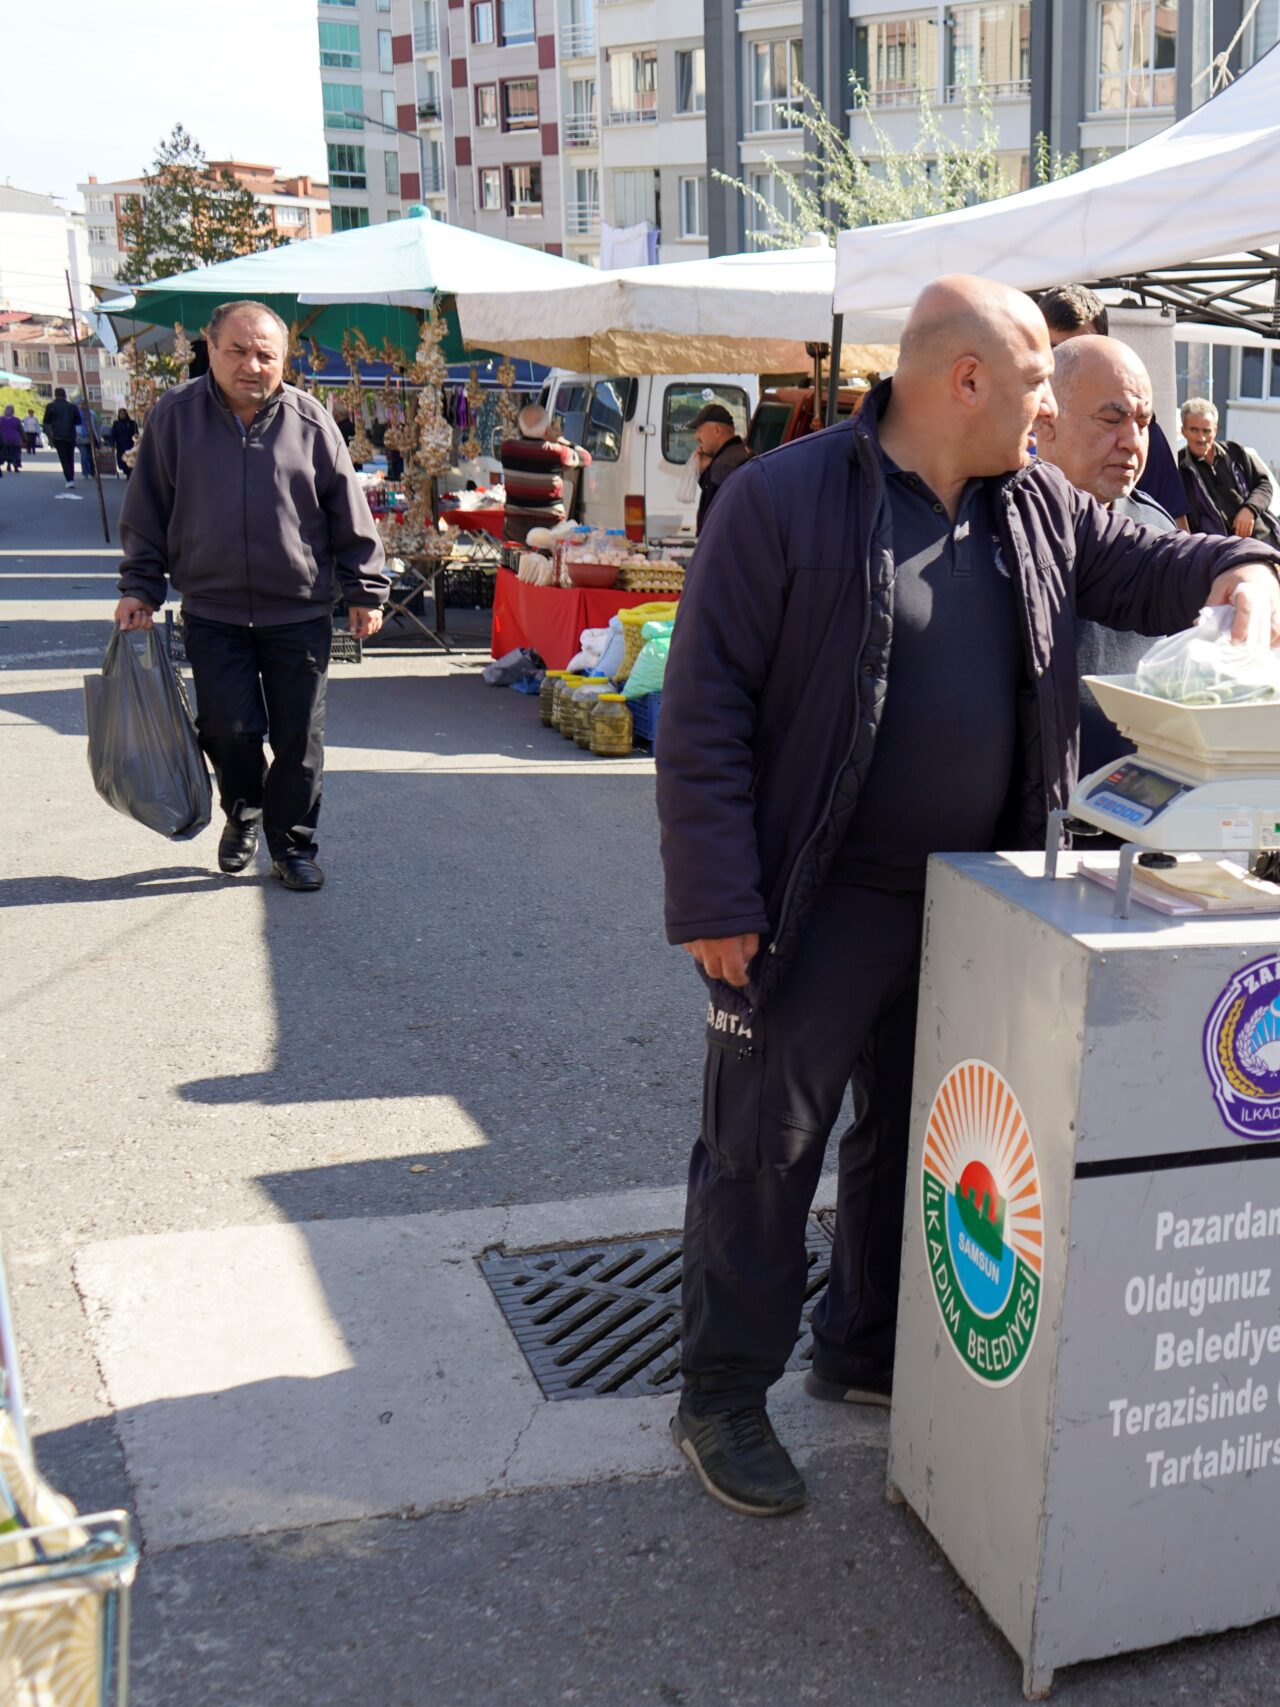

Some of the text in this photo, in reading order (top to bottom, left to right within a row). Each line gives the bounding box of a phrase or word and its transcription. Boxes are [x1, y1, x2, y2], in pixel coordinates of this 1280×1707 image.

[926, 1178, 1037, 1372] İLKADIM BELEDİYESİ
[957, 1232, 1000, 1285] SAMSUN
[1124, 1266, 1272, 1317] Olduğunuz
[1108, 1377, 1269, 1438] Terazisinde
